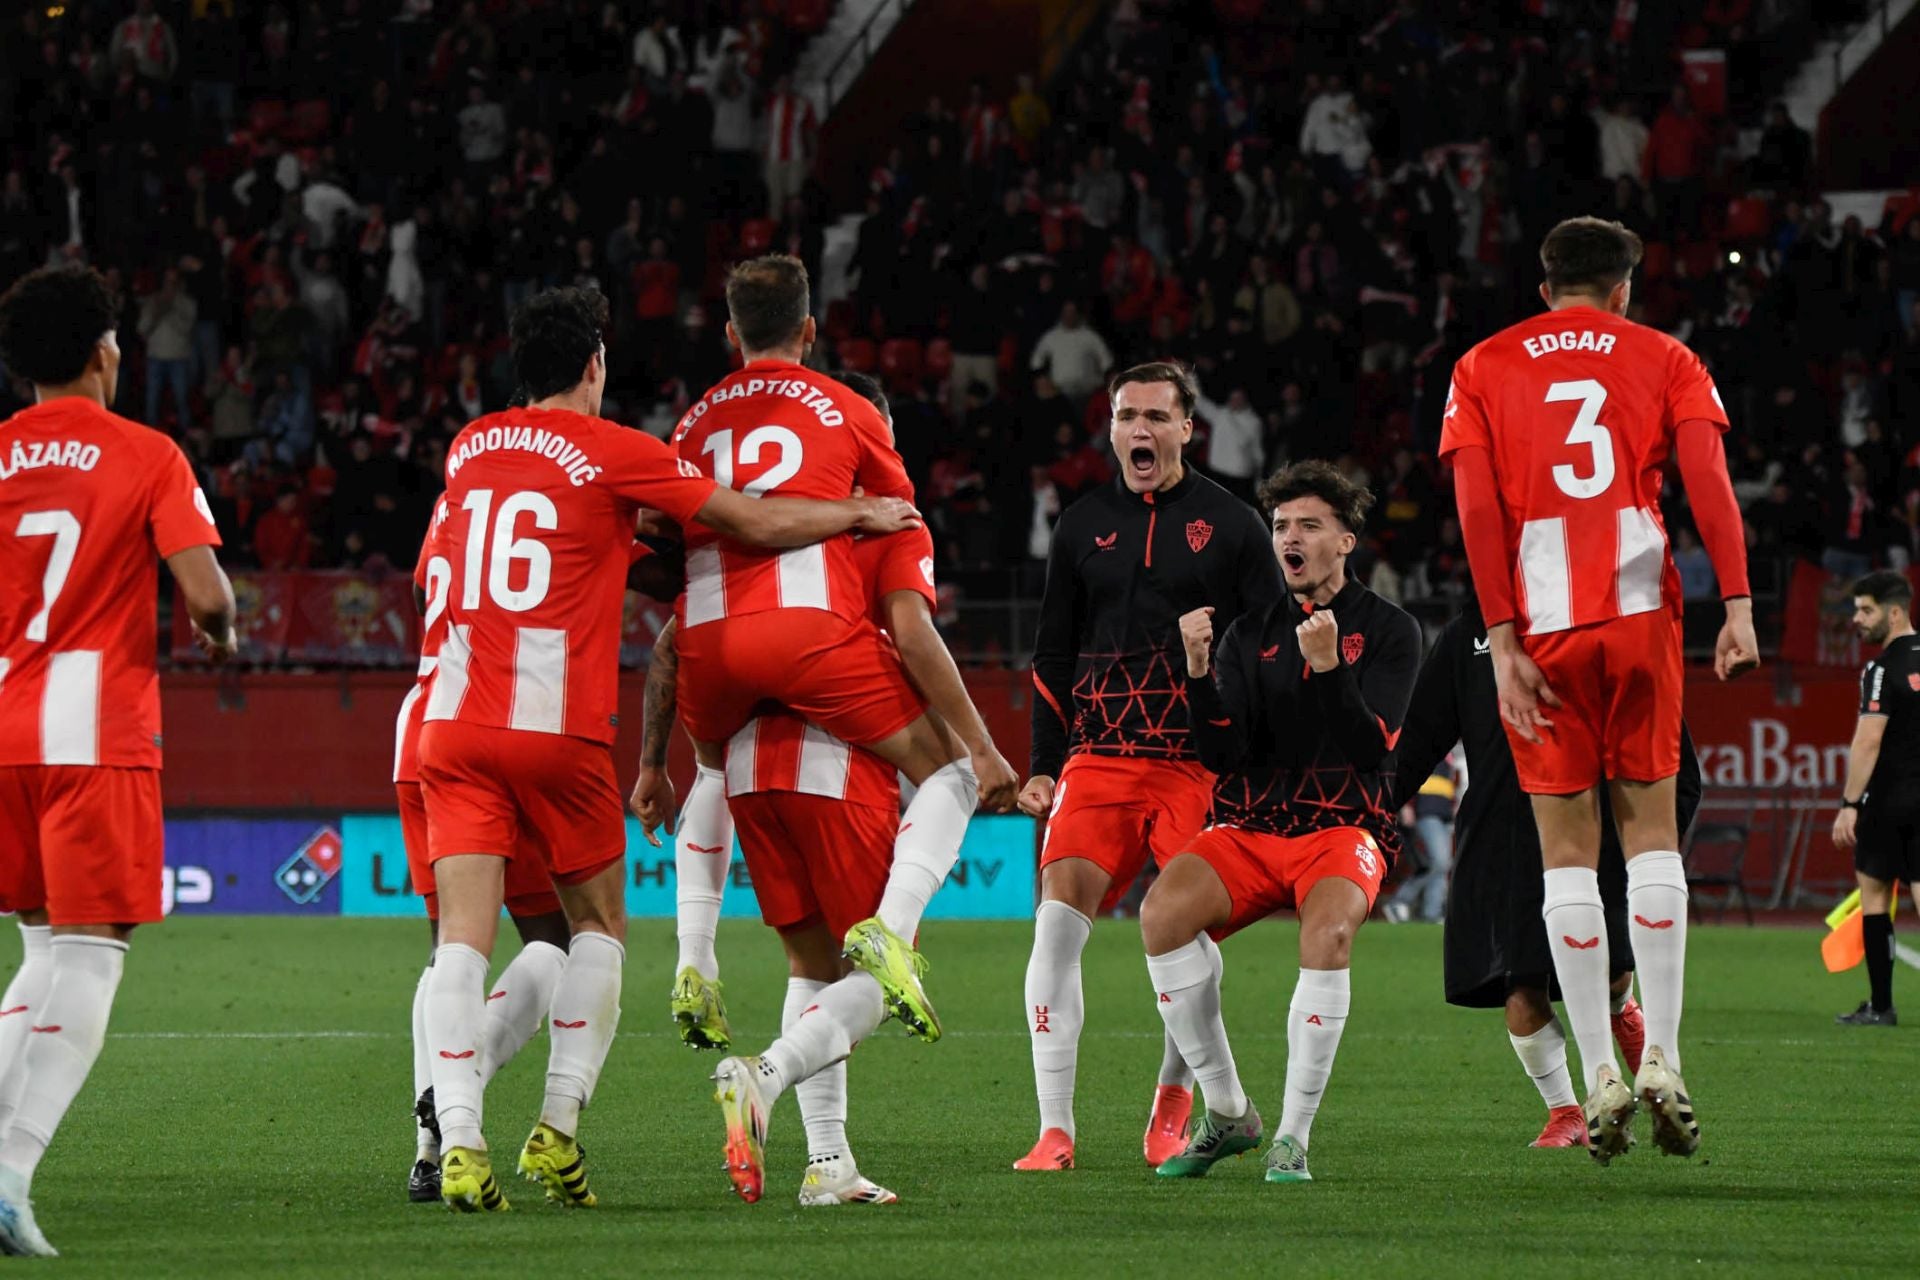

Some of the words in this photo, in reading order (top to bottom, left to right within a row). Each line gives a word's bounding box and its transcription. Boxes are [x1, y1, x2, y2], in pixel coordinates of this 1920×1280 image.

[1522, 331, 1617, 359] EDGAR
[676, 400, 708, 441] LEO
[1544, 379, 1616, 499] 3
[0, 440, 101, 480] LÁZARO
[701, 425, 803, 499] 12
[15, 510, 81, 642] 7
[461, 489, 558, 612] 16
[1697, 719, 1851, 788] xaBan
[1035, 1005, 1050, 1033] UDA
